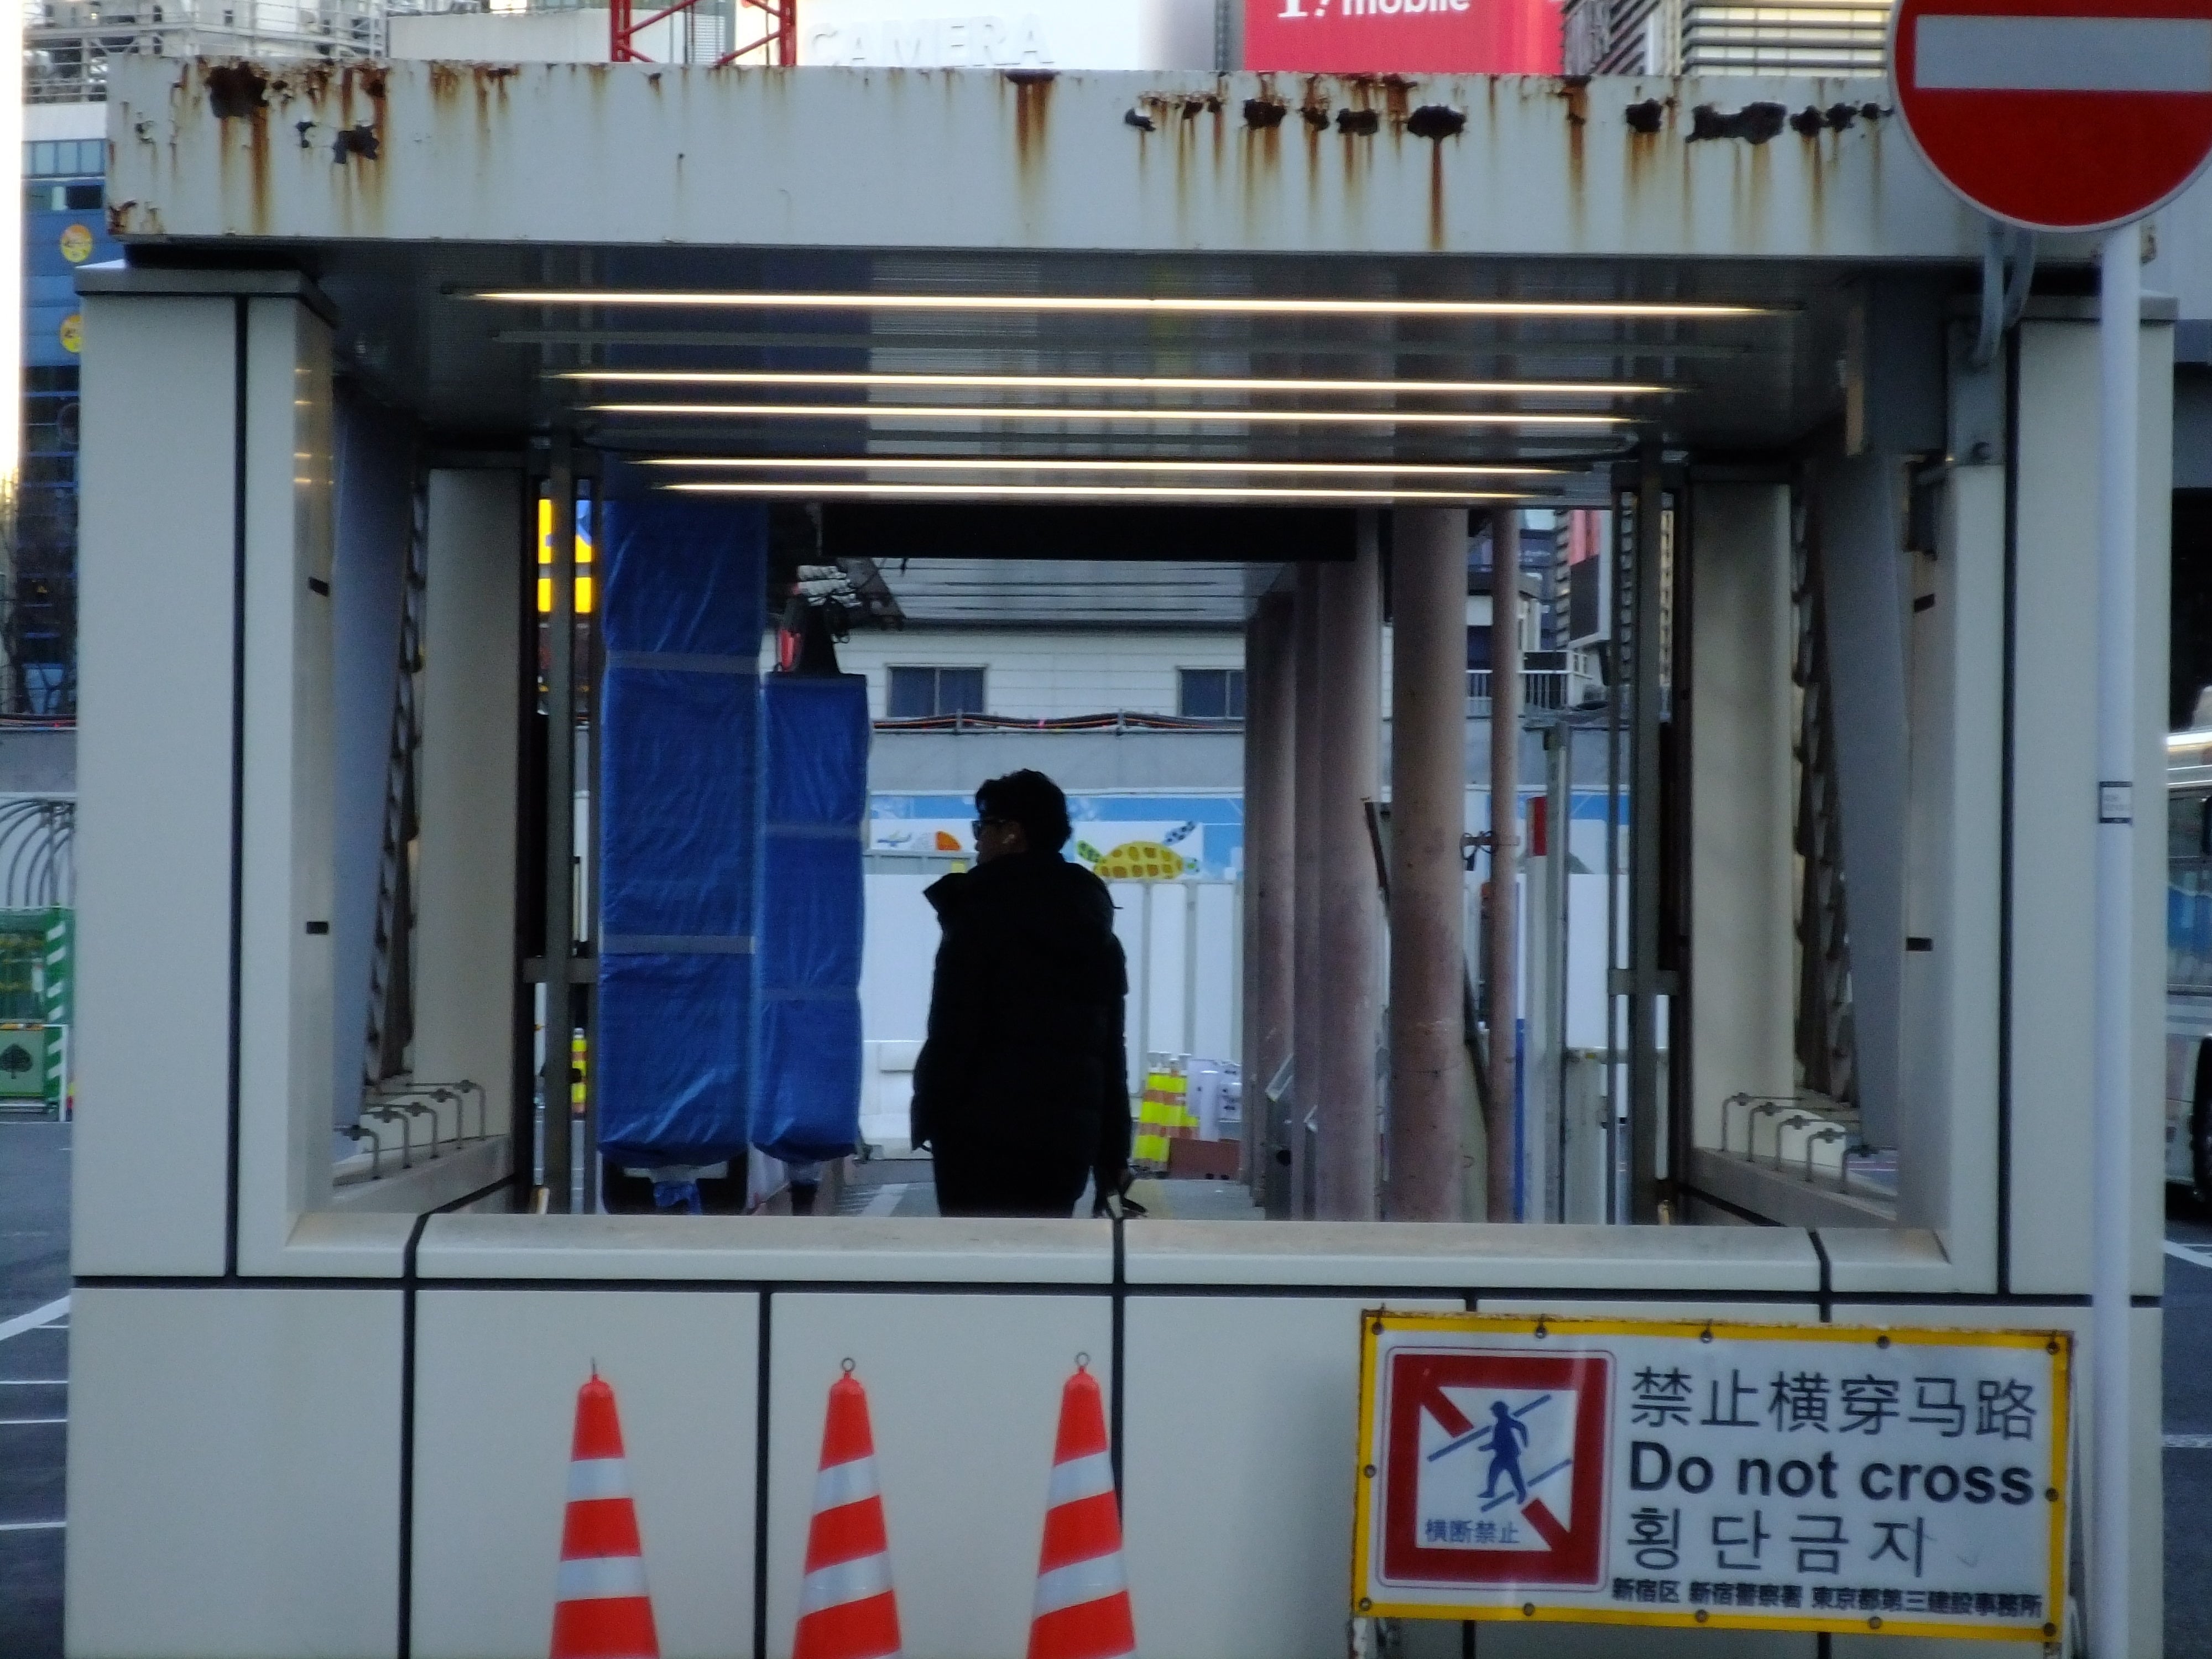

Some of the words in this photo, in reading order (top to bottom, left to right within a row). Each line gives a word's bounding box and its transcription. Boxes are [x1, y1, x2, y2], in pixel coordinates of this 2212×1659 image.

[806, 14, 1056, 66] CAMERA
[1632, 1366, 2037, 1440] 禁止横穿马路
[1630, 1441, 1714, 1494] Do
[1738, 1452, 1839, 1498] not
[1860, 1462, 2034, 1505] cross
